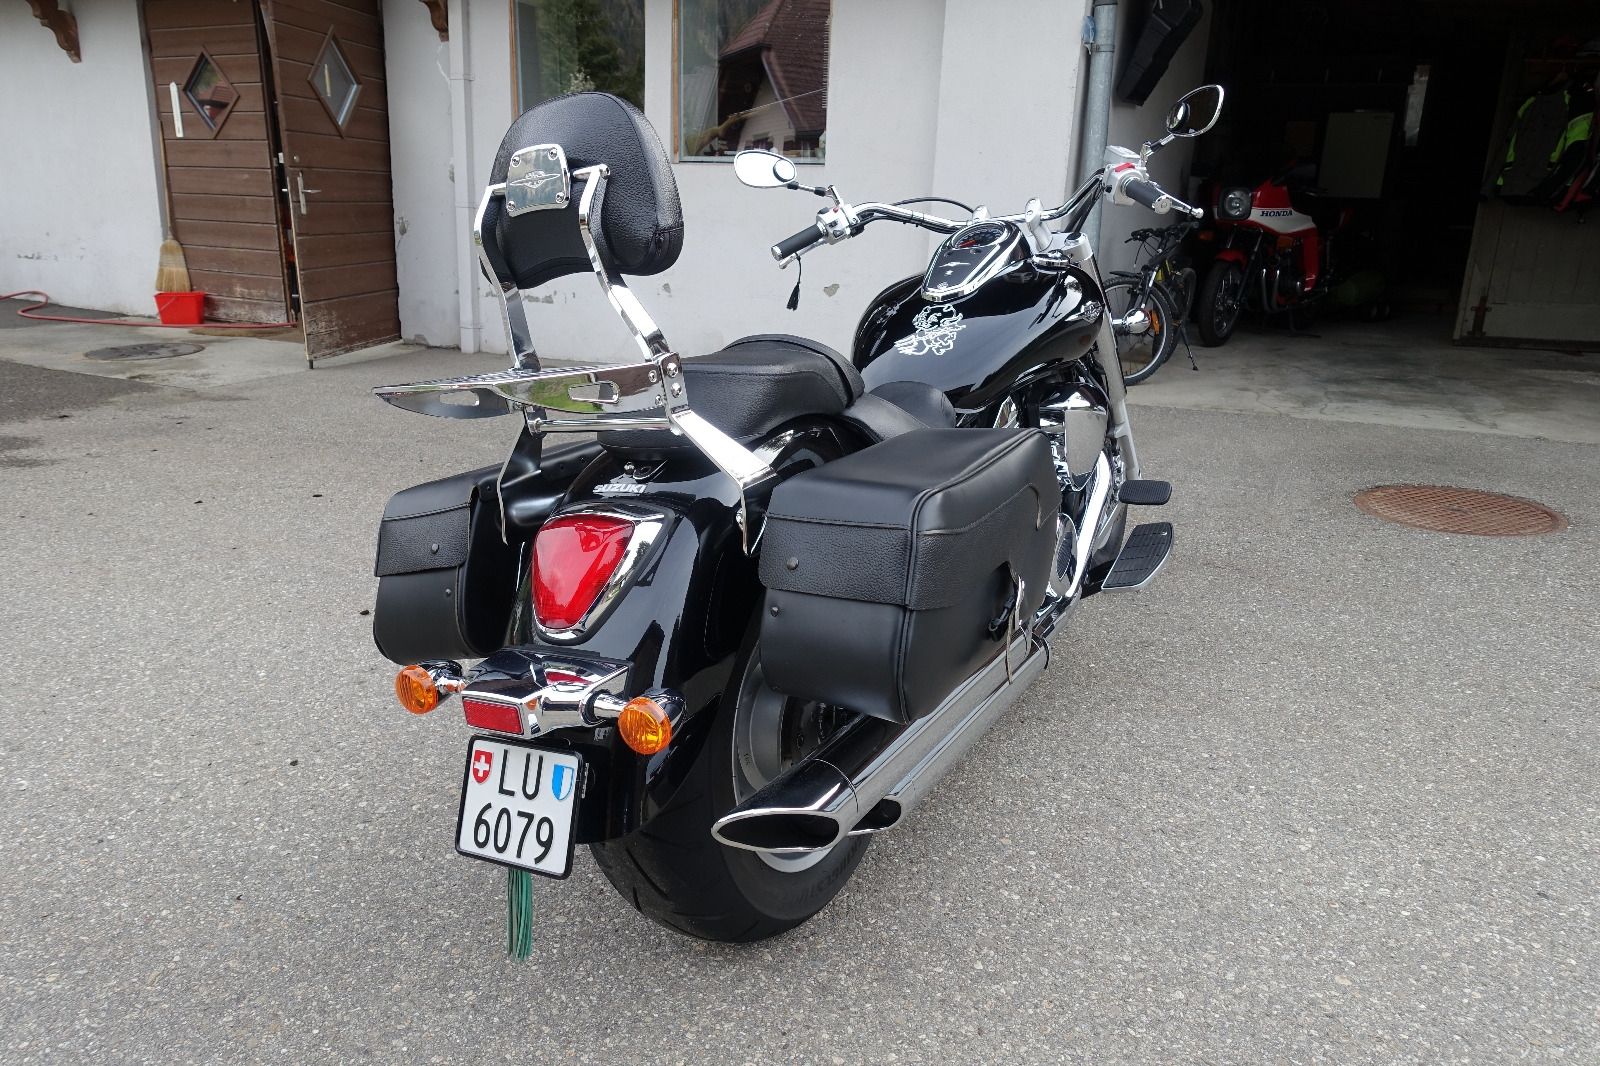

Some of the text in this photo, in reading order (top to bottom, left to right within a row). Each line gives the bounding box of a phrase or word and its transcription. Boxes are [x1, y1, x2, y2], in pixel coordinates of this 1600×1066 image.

[592, 483, 647, 494] SUZUKI
[498, 749, 543, 800] LU
[473, 802, 554, 865] 6079
